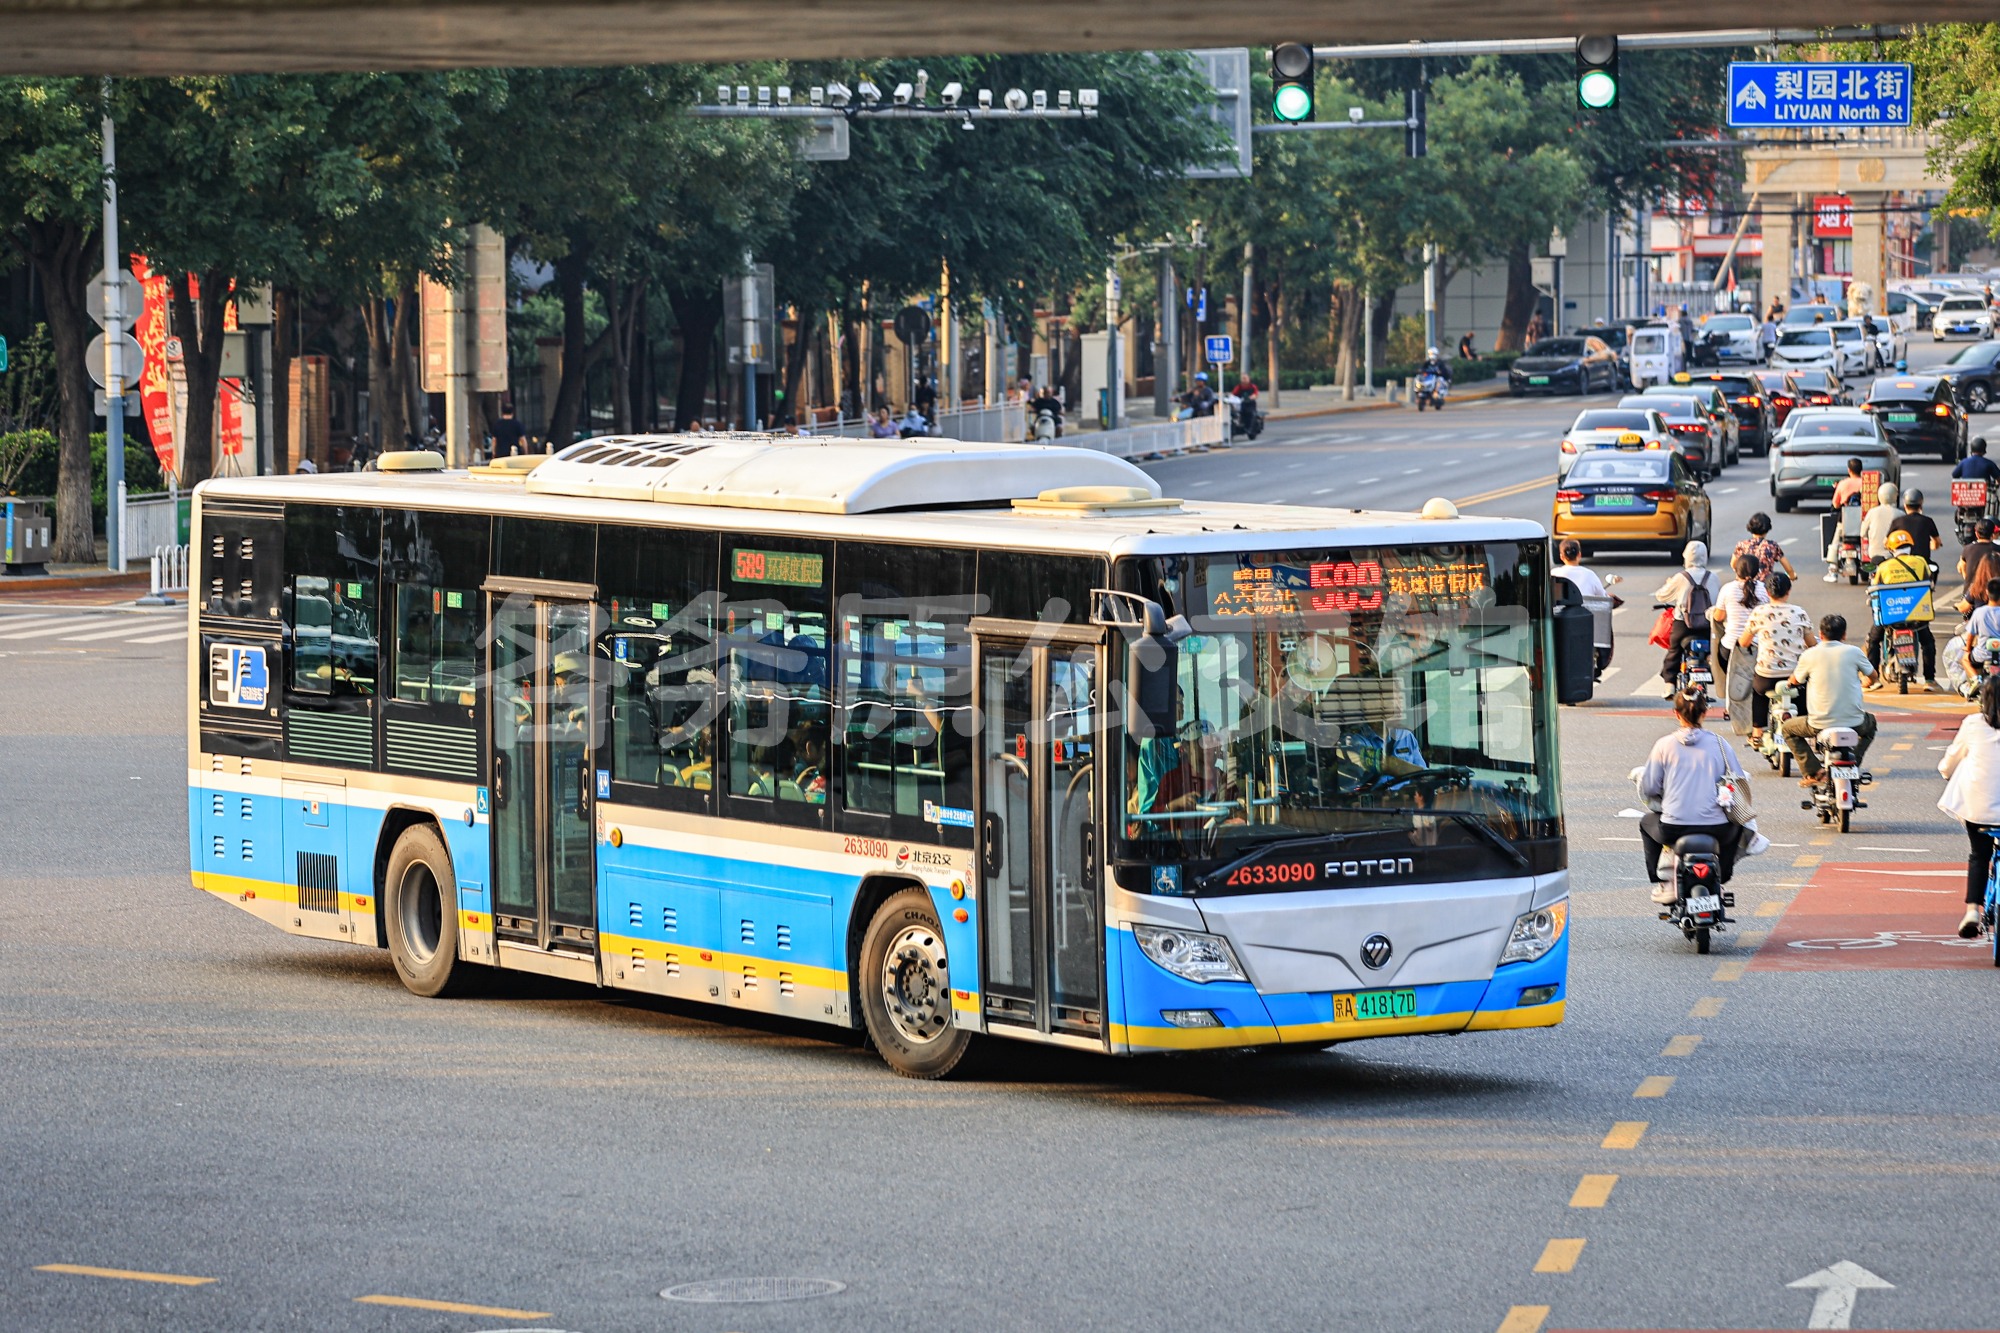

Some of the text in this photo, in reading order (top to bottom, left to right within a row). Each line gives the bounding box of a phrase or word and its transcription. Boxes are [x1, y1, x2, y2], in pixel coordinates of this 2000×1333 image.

[1747, 86, 1757, 99] 北
[1774, 70, 1903, 100] 梨园北街
[1774, 104, 1903, 120] LIYUAN North St
[736, 552, 765, 580] 589
[844, 837, 888, 859] 2633090
[912, 850, 951, 866] 北京公交
[1226, 857, 1414, 885] 2633090 FOTON
